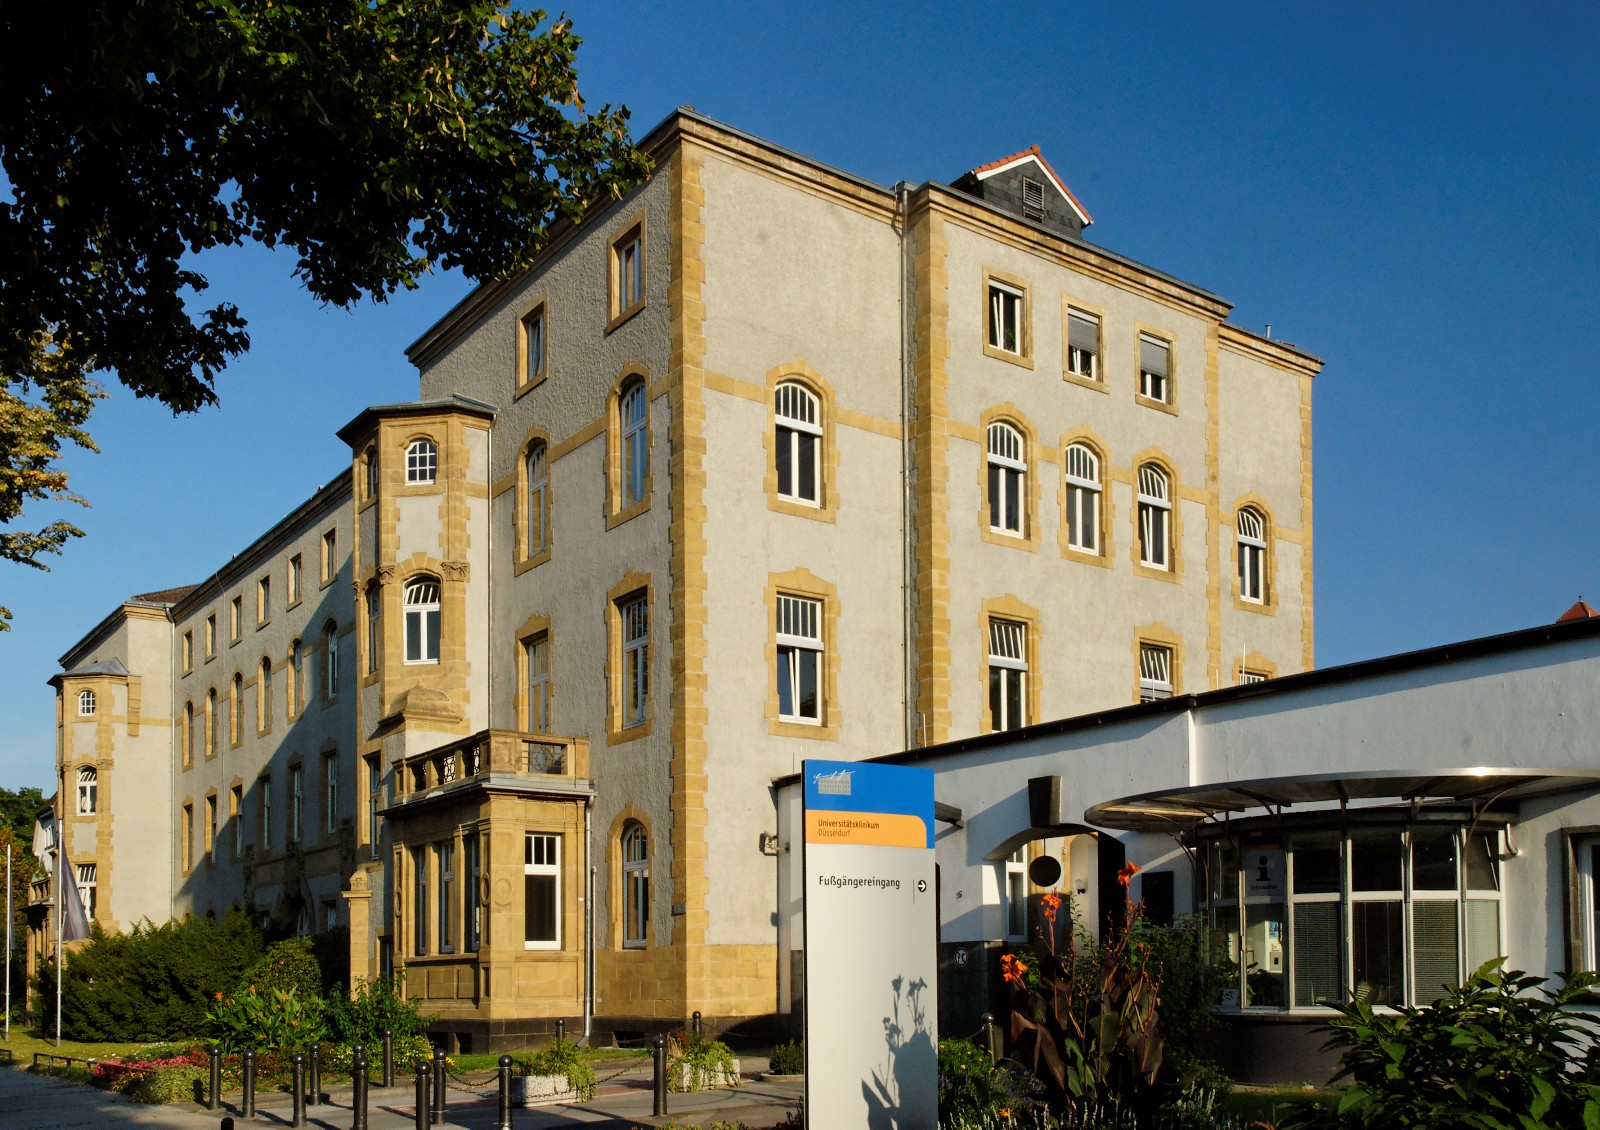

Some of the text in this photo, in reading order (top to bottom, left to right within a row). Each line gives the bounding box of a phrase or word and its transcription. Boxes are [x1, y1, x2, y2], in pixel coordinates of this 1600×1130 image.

[818, 819, 880, 829] Universitätsklinikum
[818, 828, 851, 837] Düsseldorf
[818, 875, 900, 890] Fußgängereingang
